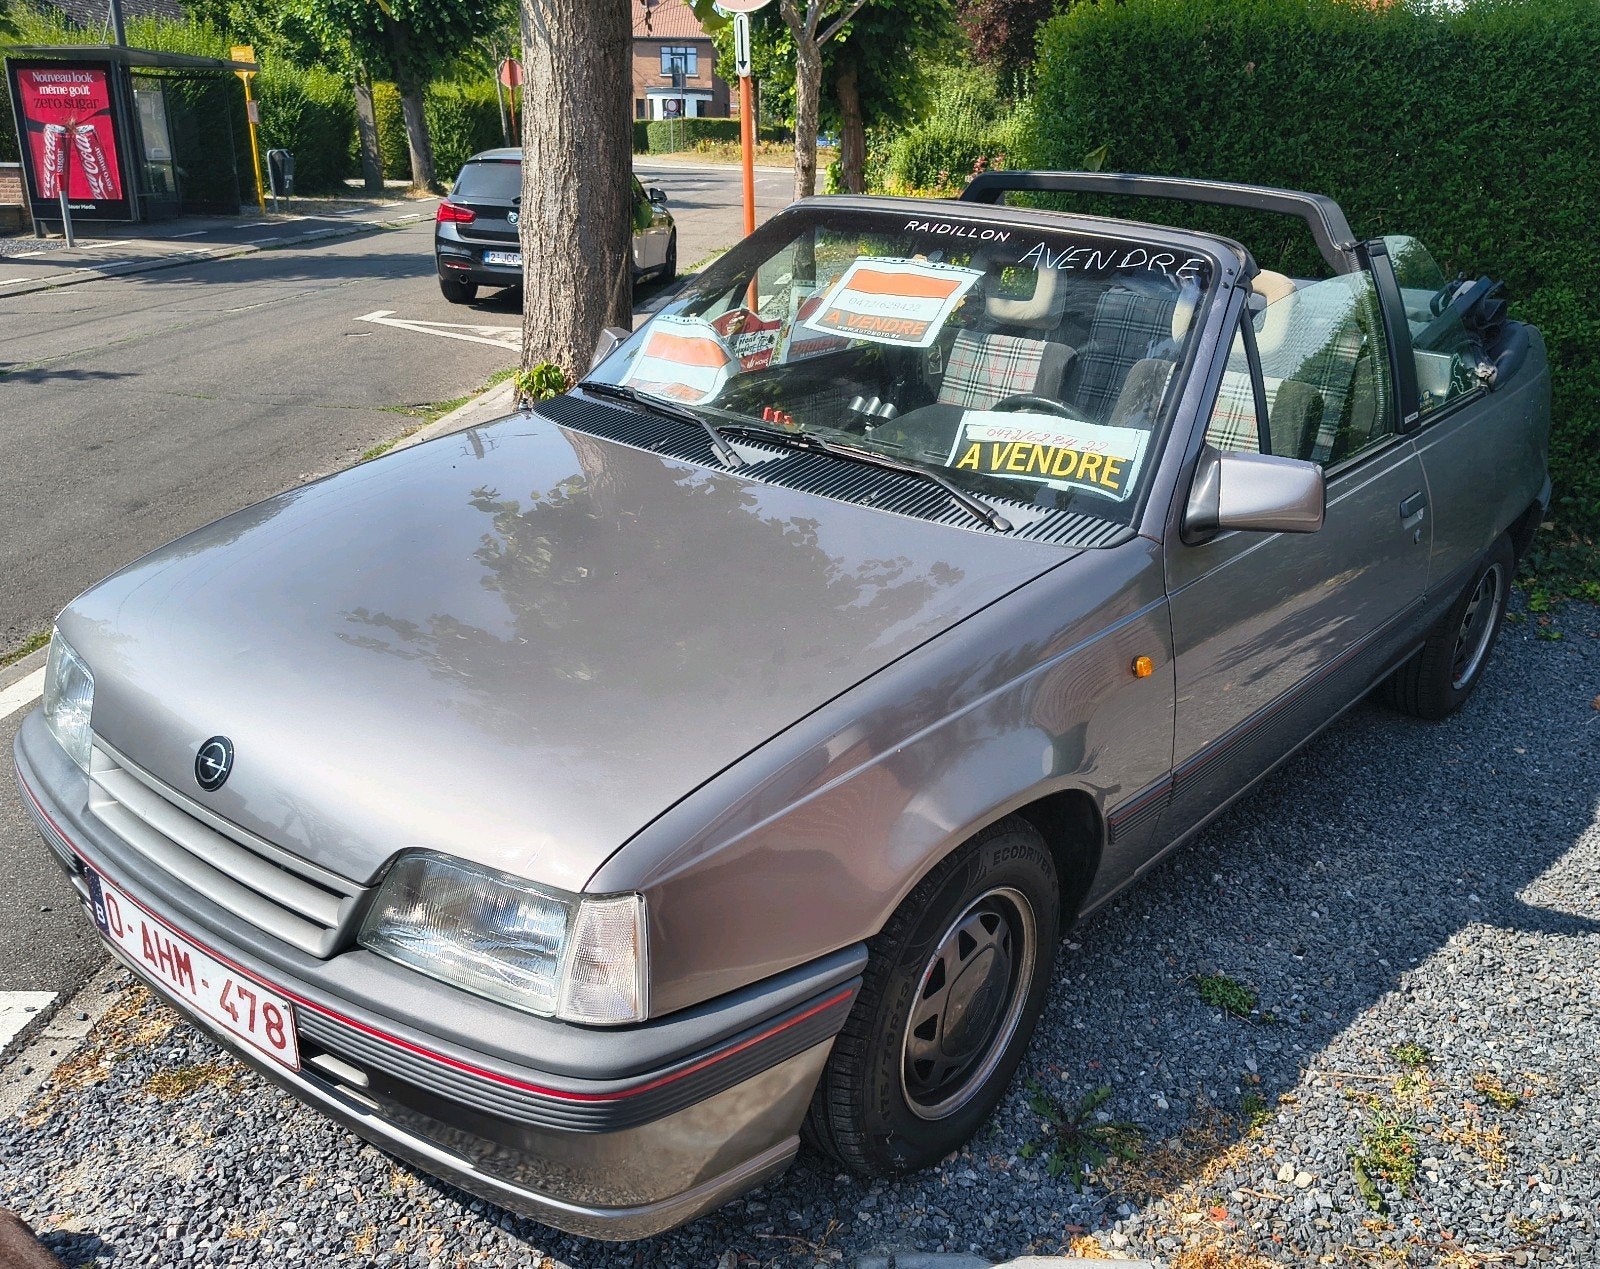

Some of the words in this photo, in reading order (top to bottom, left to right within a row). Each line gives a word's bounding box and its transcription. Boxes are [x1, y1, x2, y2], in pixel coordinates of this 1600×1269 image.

[32, 71, 71, 83] Nouveau
[72, 71, 94, 83] look
[39, 84, 68, 95] même
[69, 86, 91, 97] goût
[33, 97, 62, 109] zero
[63, 97, 100, 111] sugar
[904, 220, 1011, 243] RAIDILLON
[826, 311, 841, 325] A
[846, 312, 928, 336] VENDRE
[956, 443, 982, 470] A
[990, 442, 1127, 490] VENDRE
[993, 845, 1052, 880] ECODRIVER
[95, 902, 106, 924] B
